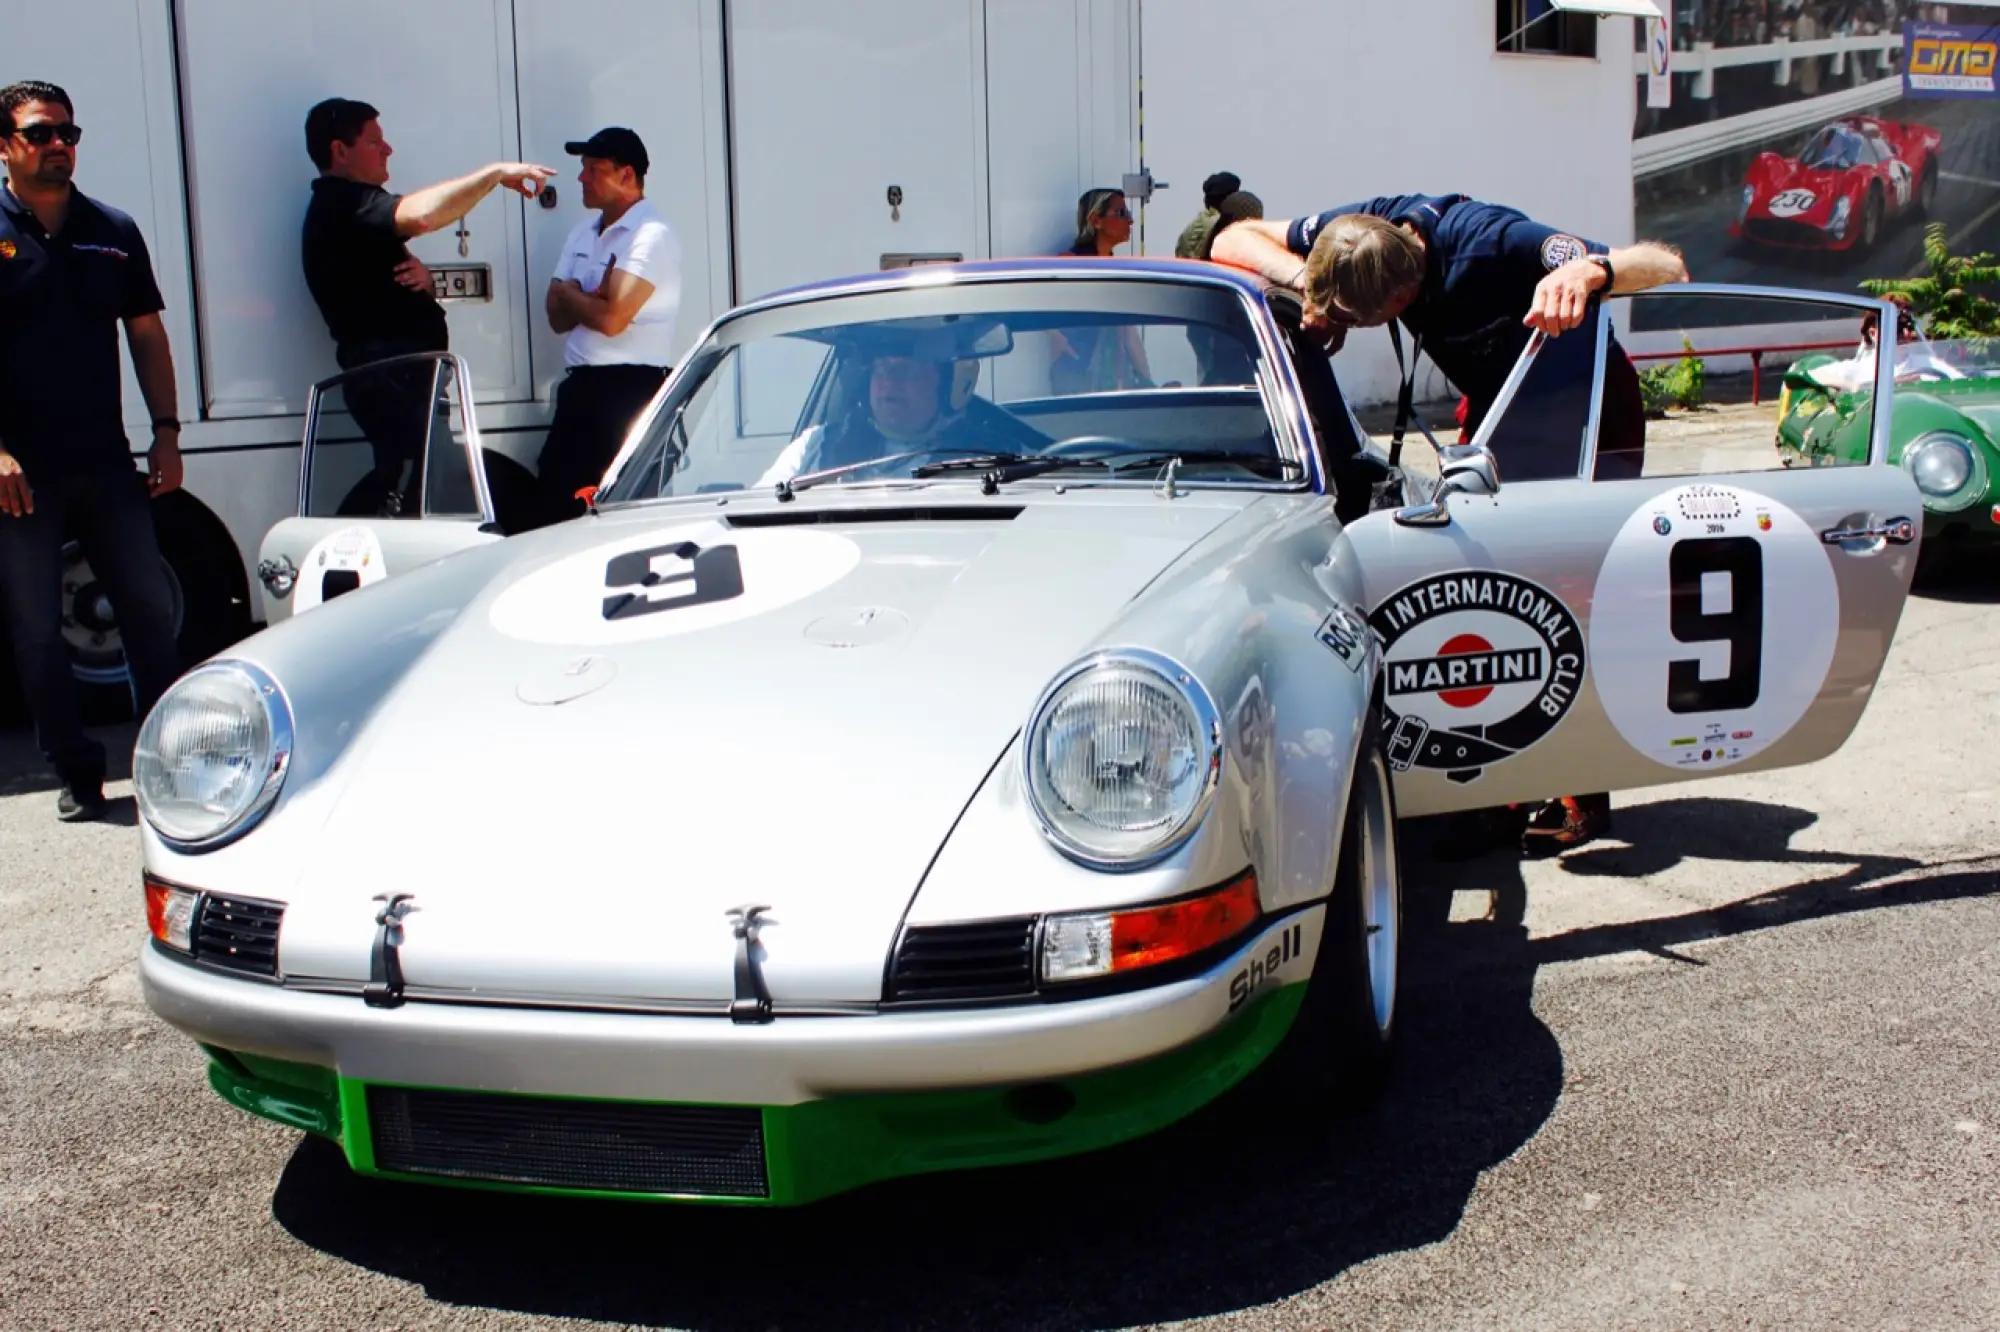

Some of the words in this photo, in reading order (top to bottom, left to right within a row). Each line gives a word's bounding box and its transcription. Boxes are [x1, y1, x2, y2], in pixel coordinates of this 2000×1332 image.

[1769, 193, 1816, 210] 230
[1384, 578, 1571, 648] INTERNATIONAL
[1539, 653, 1579, 718] CLUB
[1667, 536, 1763, 714] 9
[1394, 651, 1537, 691] MARTINI
[1229, 924, 1301, 1012] Shell
